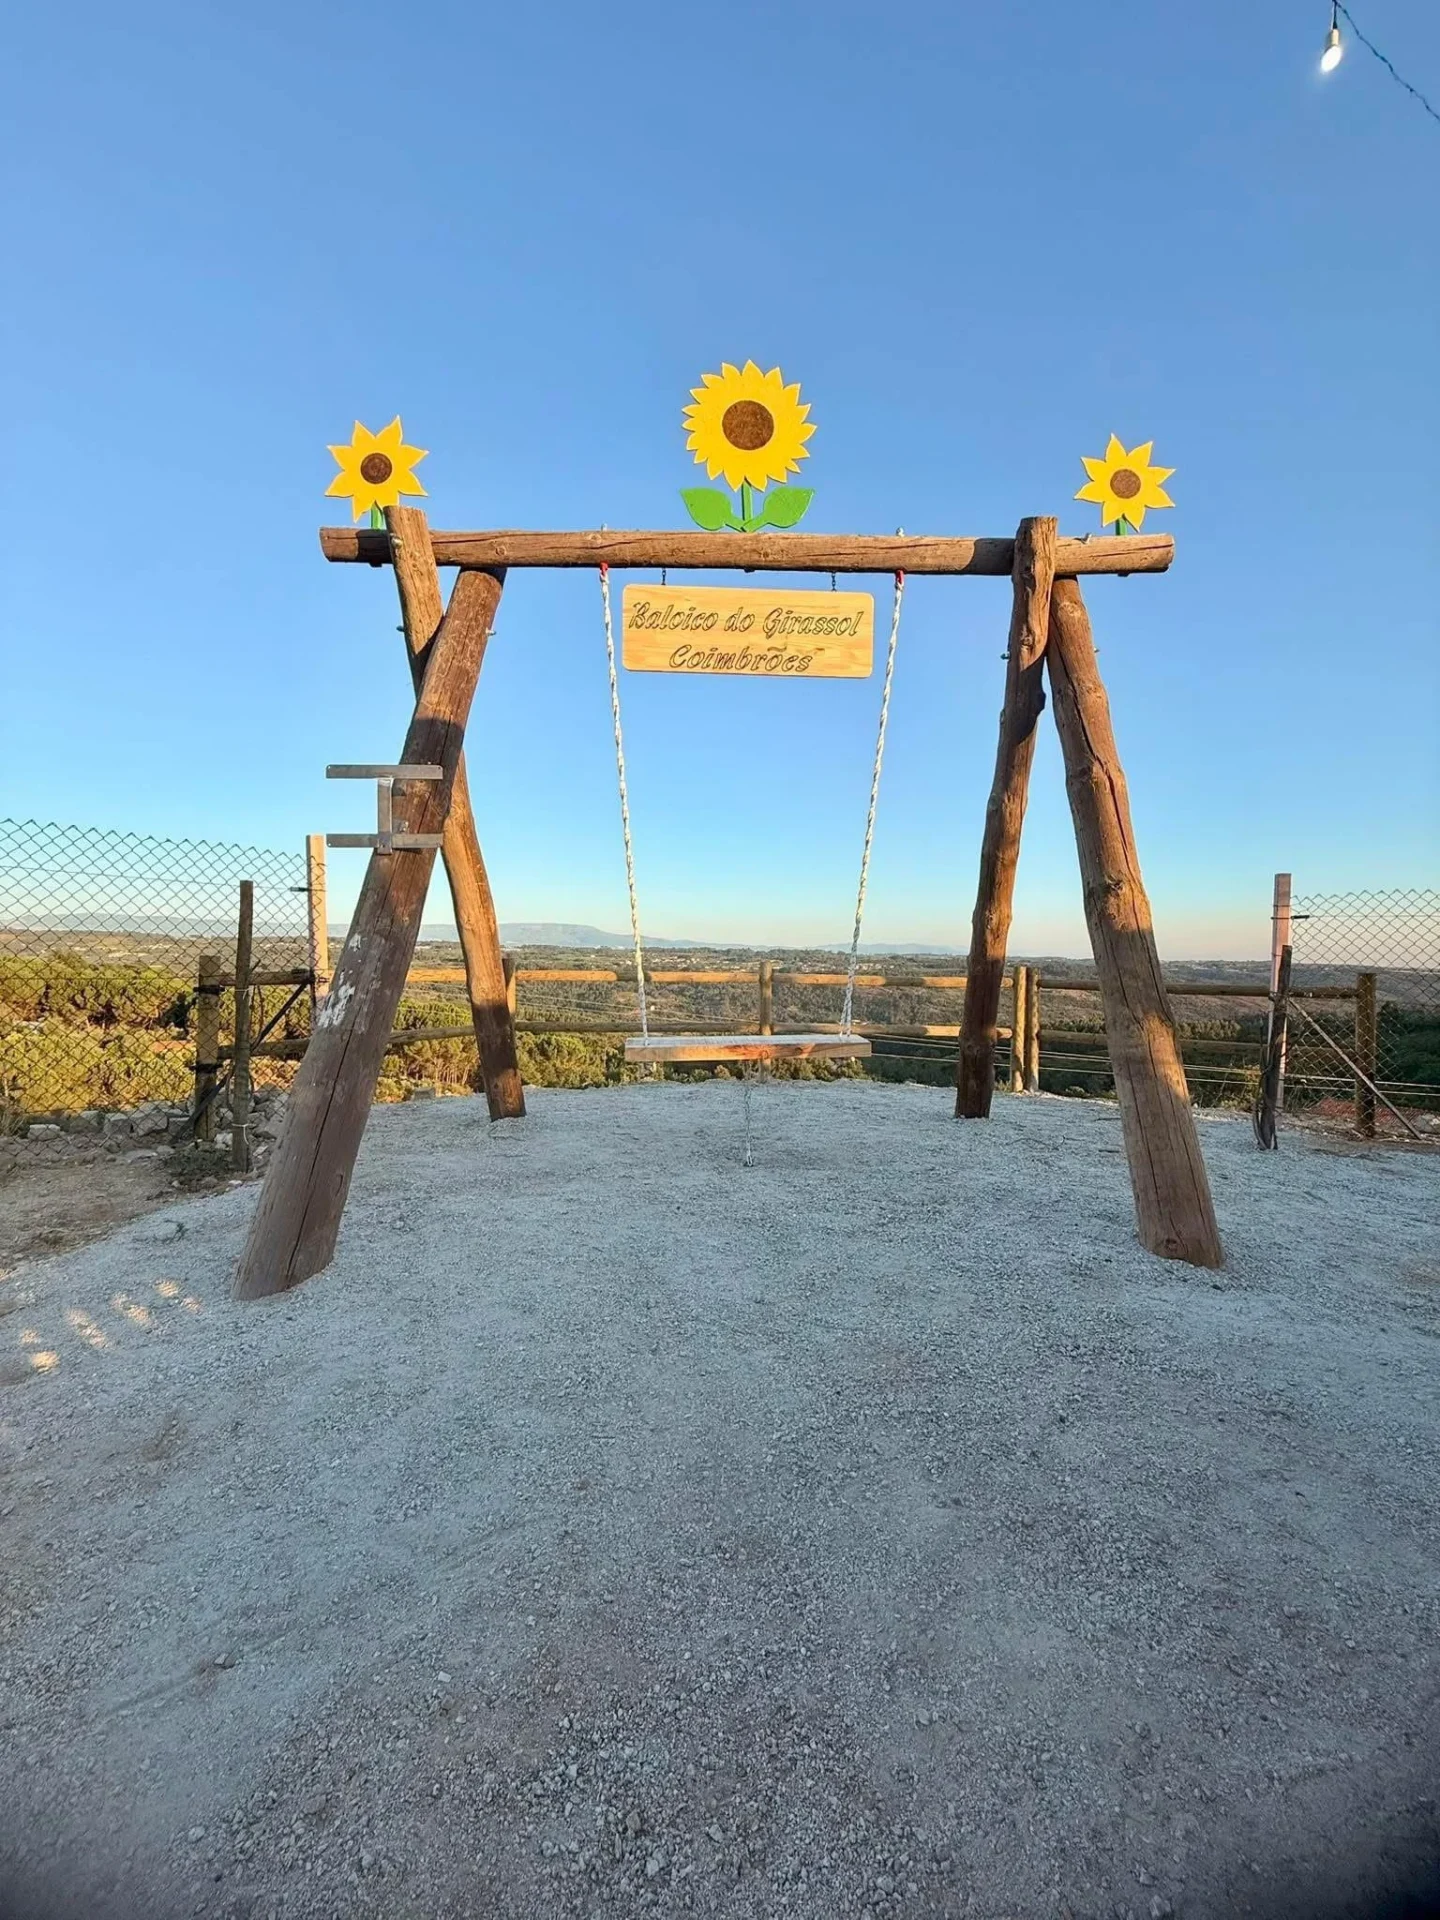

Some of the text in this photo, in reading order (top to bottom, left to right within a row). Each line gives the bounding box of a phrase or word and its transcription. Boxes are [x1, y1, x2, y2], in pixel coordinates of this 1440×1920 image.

[723, 607, 756, 632] do
[762, 607, 864, 639] Girassol
[669, 644, 814, 673] Coimbrões
